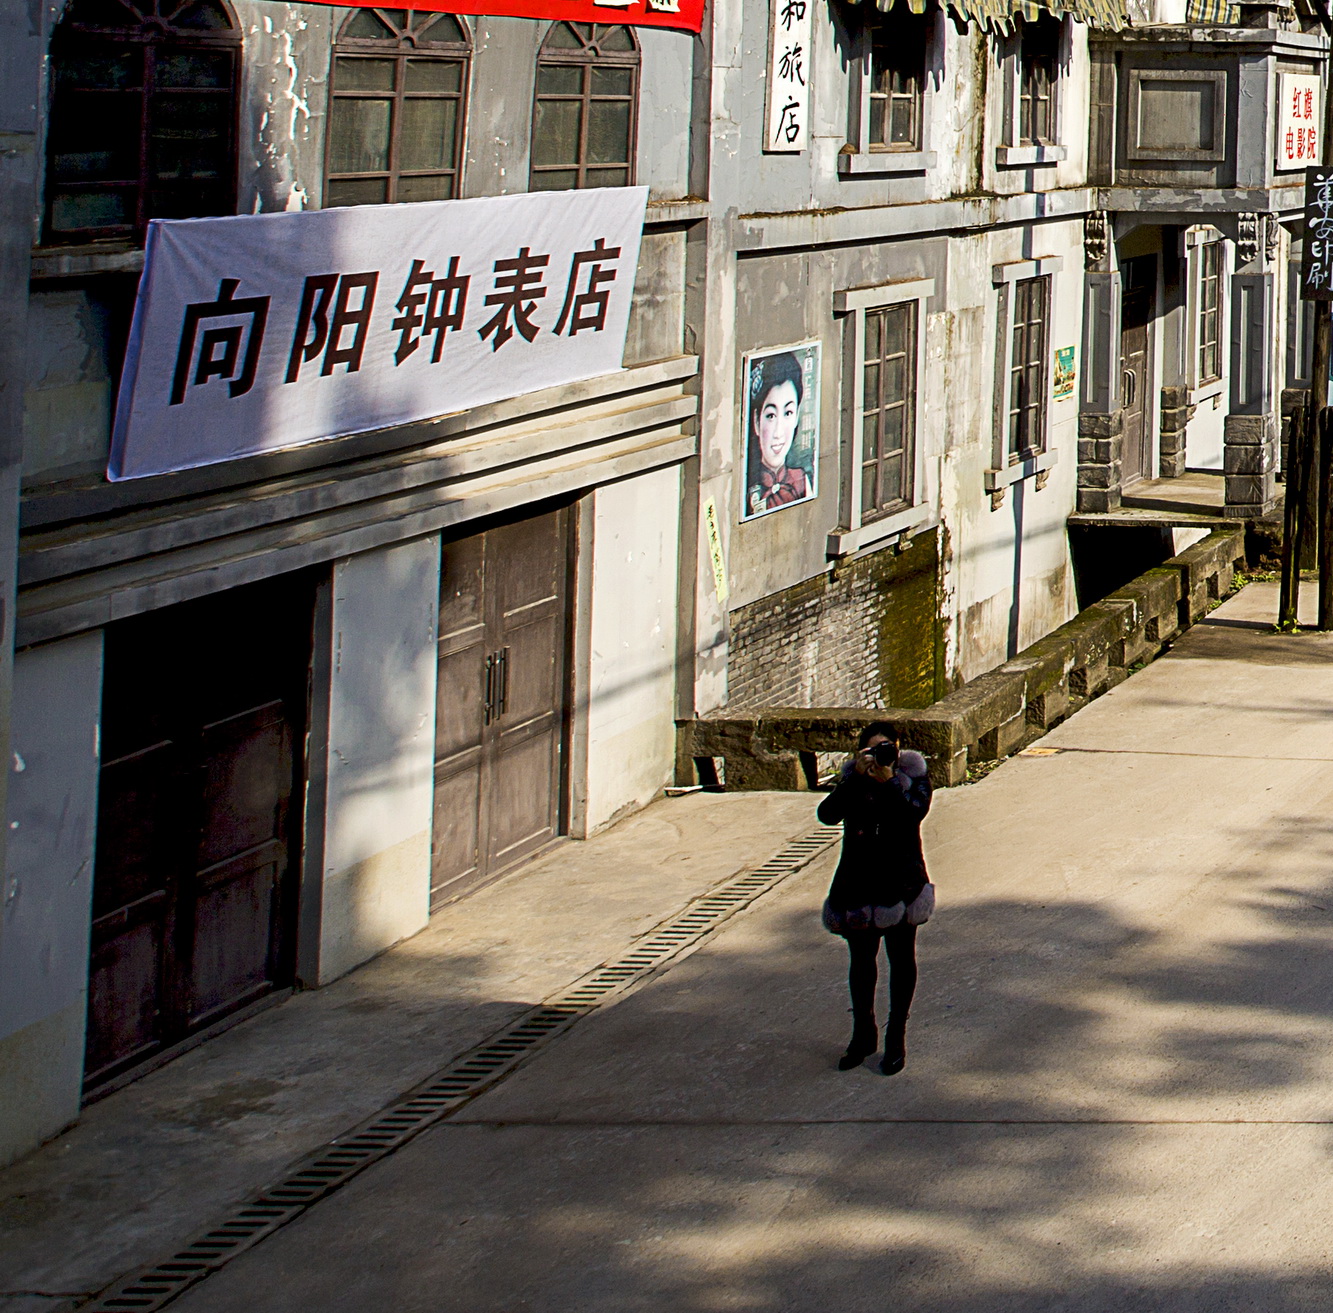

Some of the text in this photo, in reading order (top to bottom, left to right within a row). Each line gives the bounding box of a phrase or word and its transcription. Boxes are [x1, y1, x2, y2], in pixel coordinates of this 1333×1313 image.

[1292, 87, 1313, 120] 红旗
[1285, 126, 1317, 160] 电影院
[169, 238, 623, 406] 向阳钟表店
